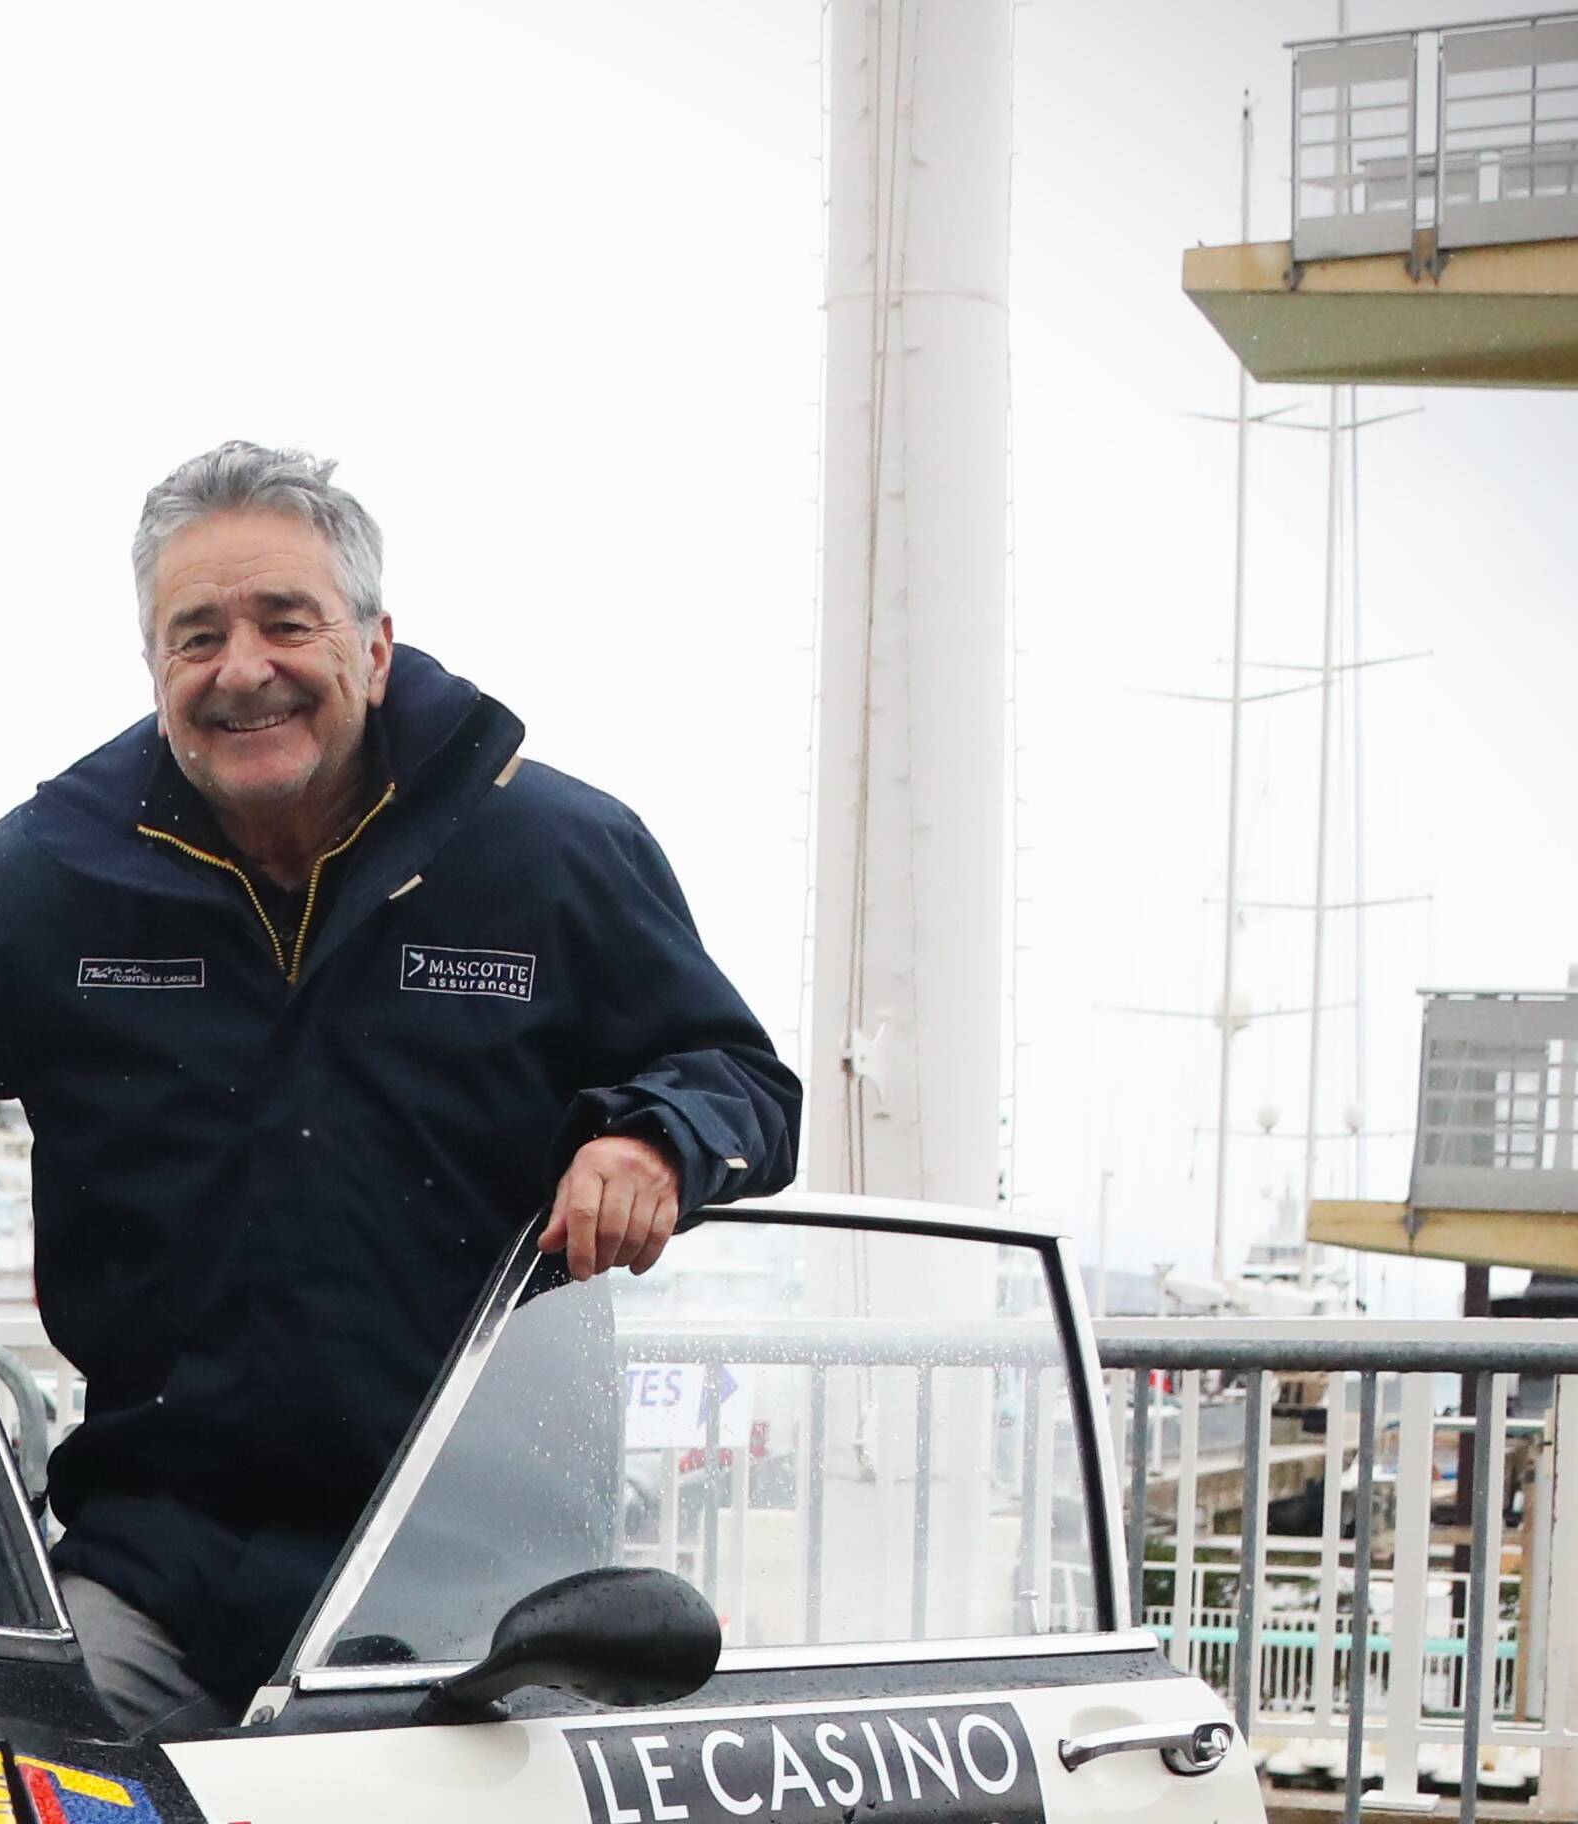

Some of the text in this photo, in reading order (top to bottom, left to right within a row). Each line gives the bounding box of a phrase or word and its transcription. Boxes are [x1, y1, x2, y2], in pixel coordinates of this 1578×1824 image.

[428, 961, 529, 983] MASCOTTE
[428, 974, 527, 996] assurances
[701, 1712, 1020, 1815] CASINO
